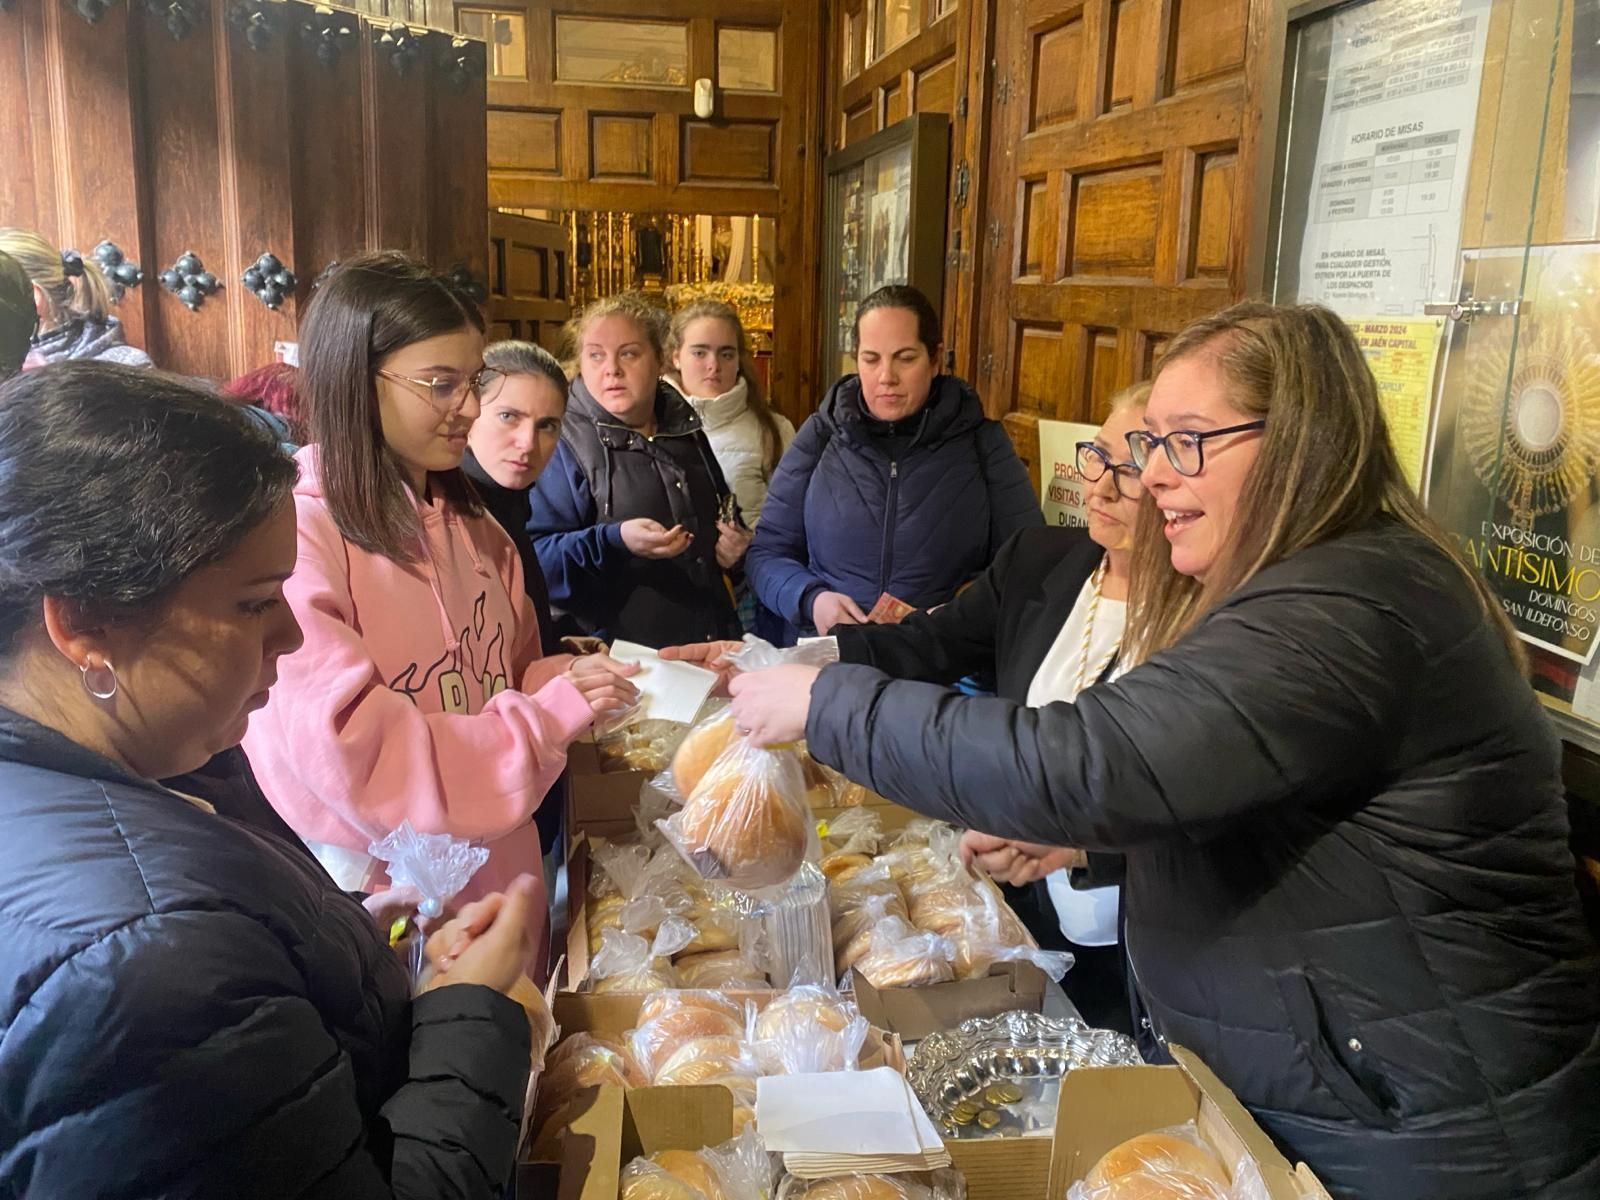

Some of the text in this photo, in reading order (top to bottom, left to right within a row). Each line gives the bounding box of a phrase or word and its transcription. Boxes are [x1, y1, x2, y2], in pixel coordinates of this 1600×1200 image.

[1351, 121, 1424, 144] HORARIO DE MISAS
[1356, 249, 1364, 257] DE
[1365, 324, 1388, 334] MARZO
[1389, 325, 1407, 334] 2024
[1369, 336, 1387, 348] JAÉN
[1388, 339, 1417, 349] CAPITAL
[1048, 484, 1080, 506] VISITAS
[1481, 520, 1575, 558] EXPOSICIÓN
[1529, 590, 1597, 623] DOMINGOS
[1502, 599, 1590, 641] SAN ILDEFONSO
